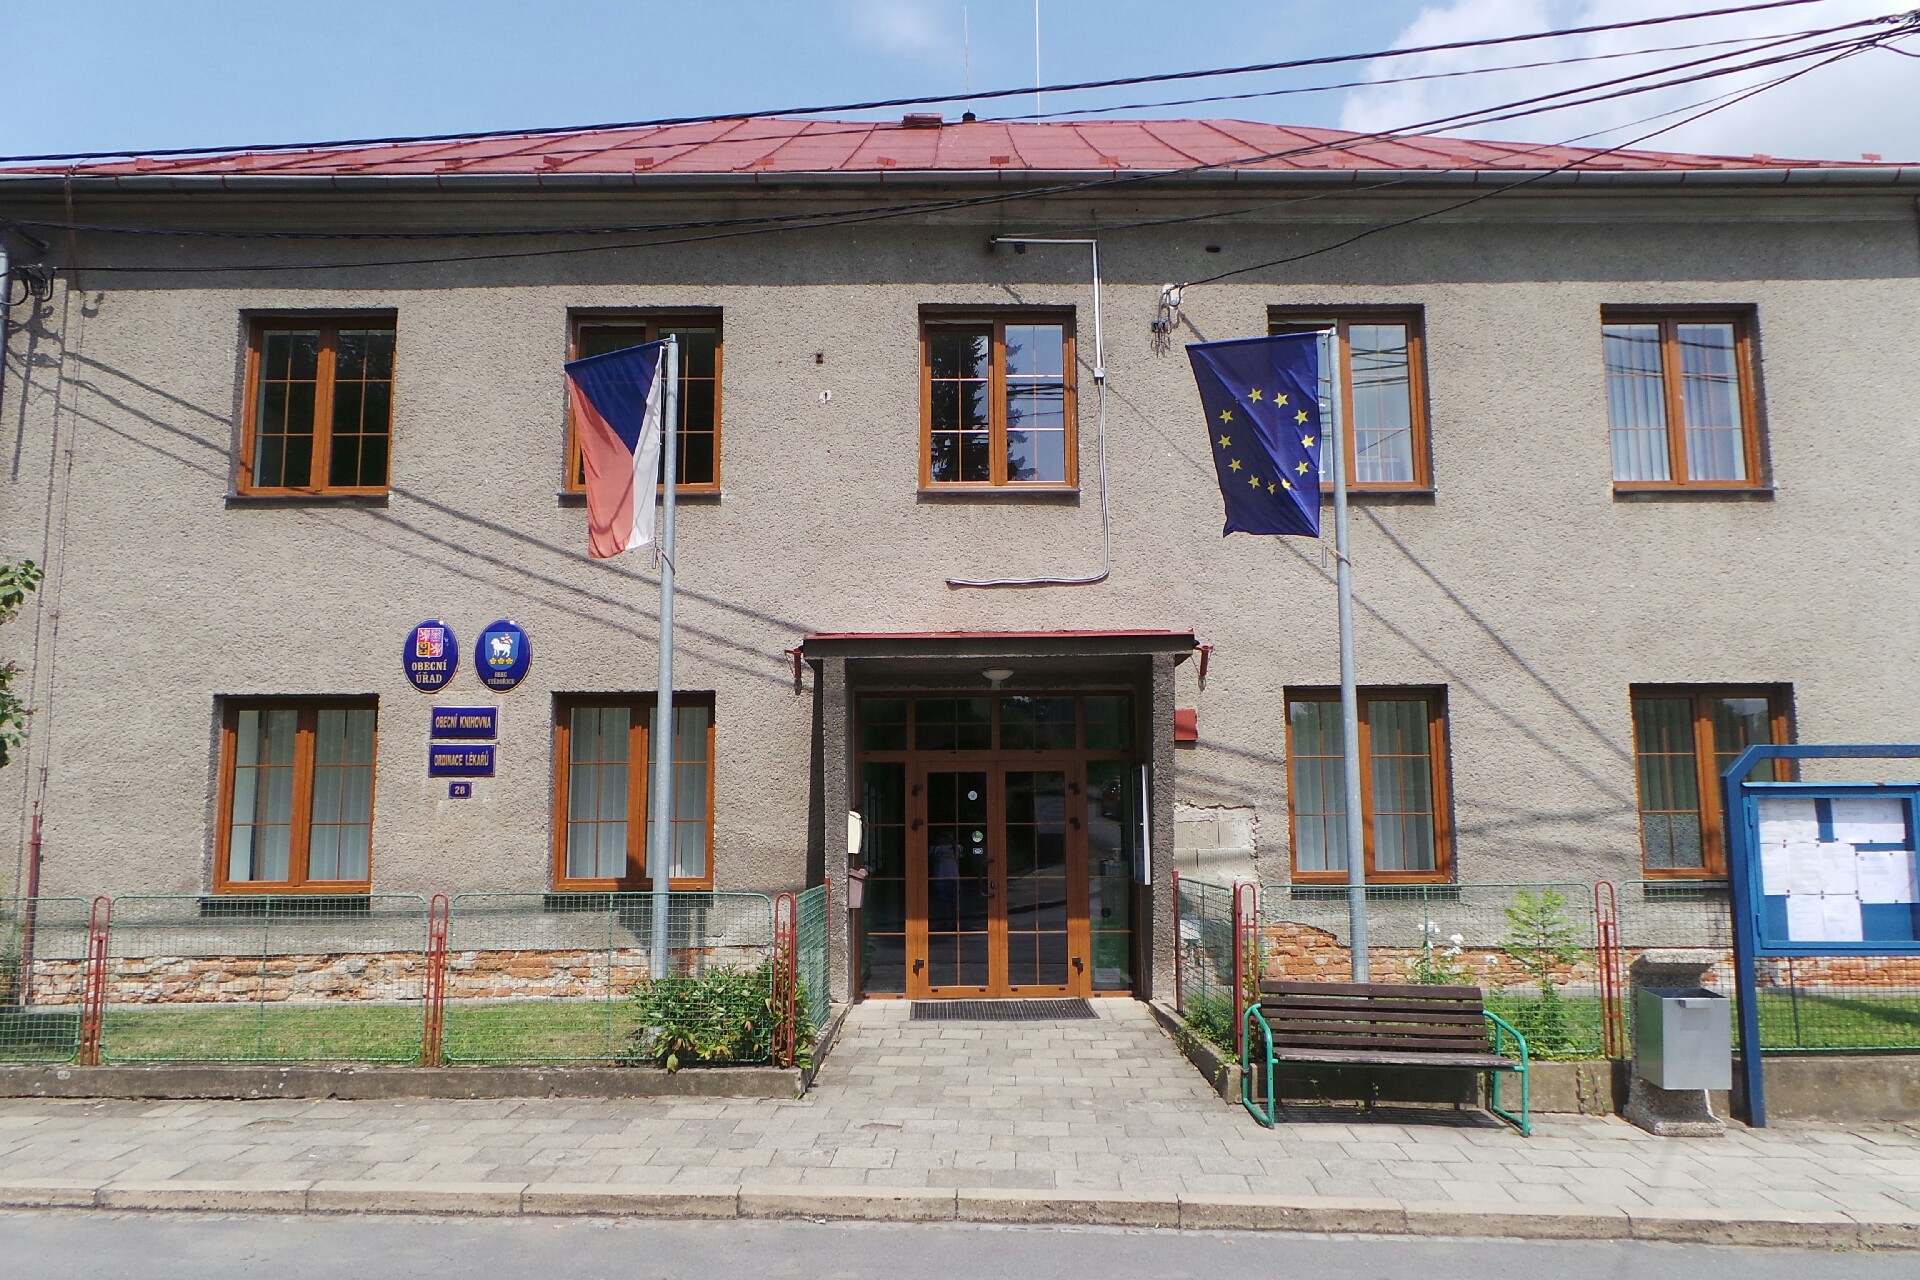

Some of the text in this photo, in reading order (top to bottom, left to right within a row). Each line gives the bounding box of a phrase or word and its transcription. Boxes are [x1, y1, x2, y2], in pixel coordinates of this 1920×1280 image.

[412, 659, 447, 671] OBECNÍ
[416, 672, 442, 684] ÚŘAD
[435, 713, 492, 728] OBECNÍ KNIHOVNA
[434, 750, 489, 766] ORDINACE LÉKAŘŮ
[454, 785, 466, 795] 28
